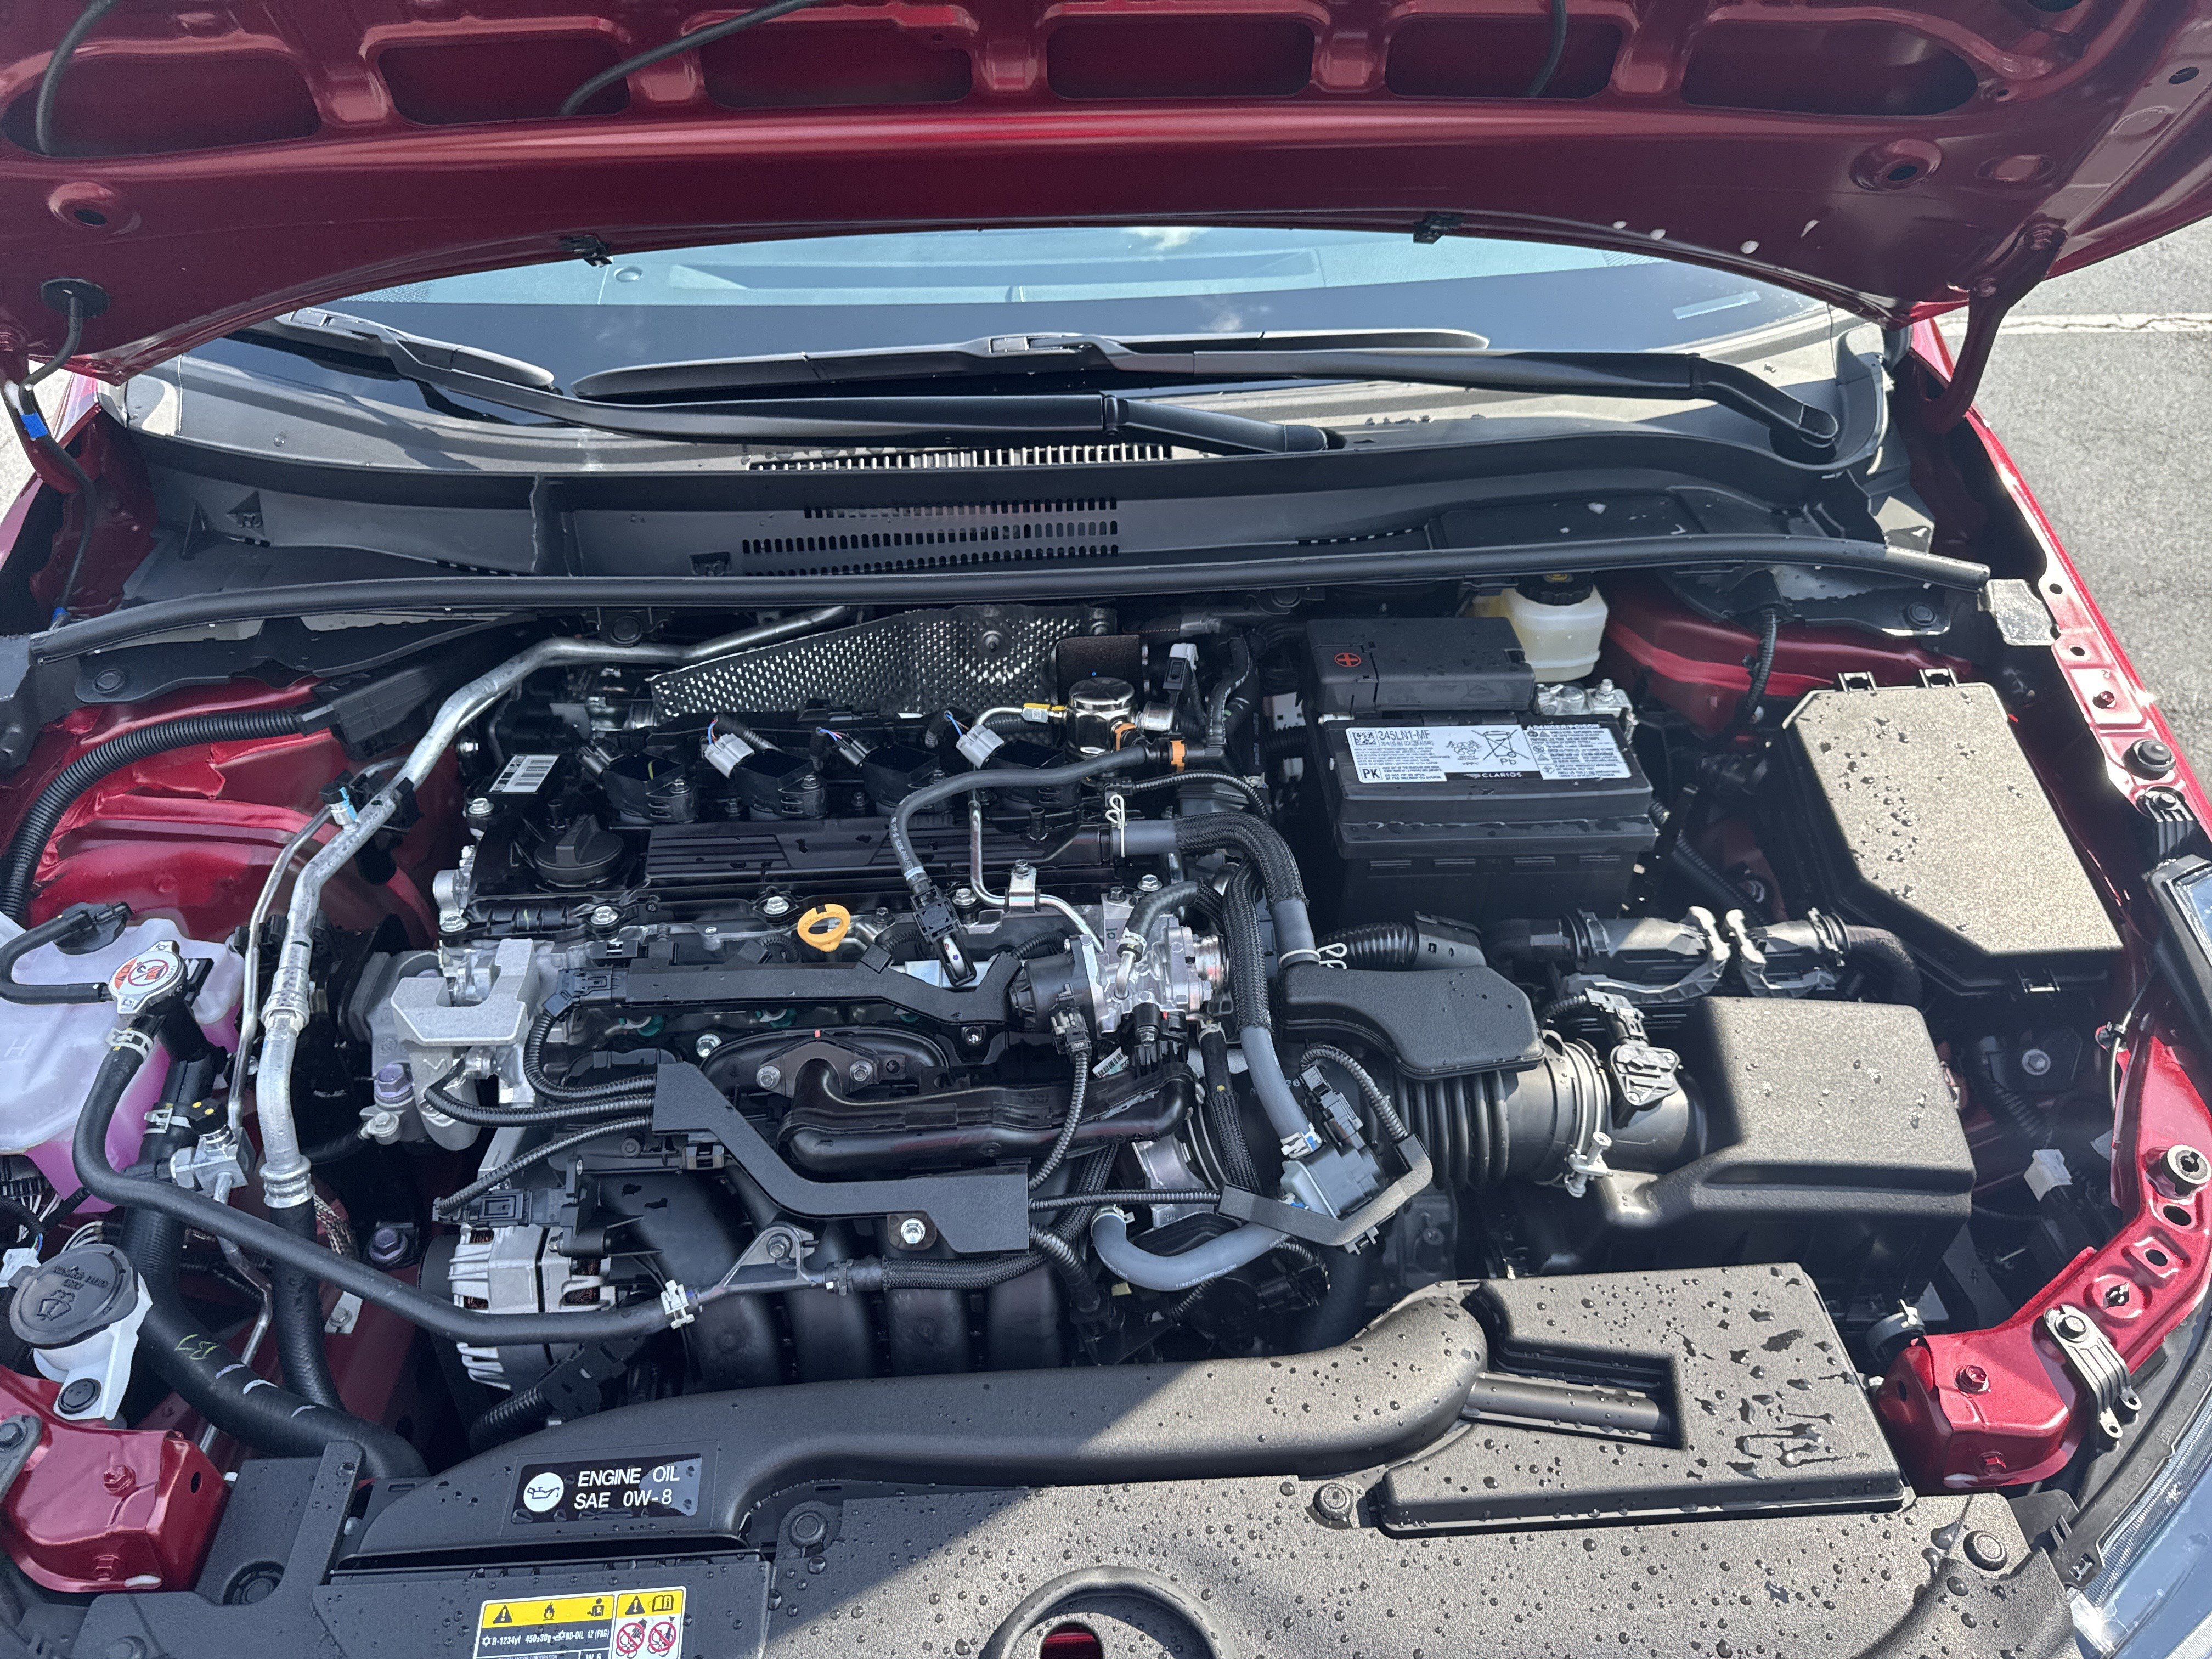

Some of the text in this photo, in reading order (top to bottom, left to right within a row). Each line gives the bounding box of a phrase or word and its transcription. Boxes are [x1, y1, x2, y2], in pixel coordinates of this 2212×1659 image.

[1362, 768, 1380, 779] PK
[578, 1465, 680, 1487] ENGINE OIL
[574, 1492, 611, 1509] SAE
[492, 1635, 521, 1646] R-1234yf
[565, 1630, 584, 1640] ND-OIL
[587, 1630, 594, 1639] 12
[595, 1628, 610, 1640] (PAG)
